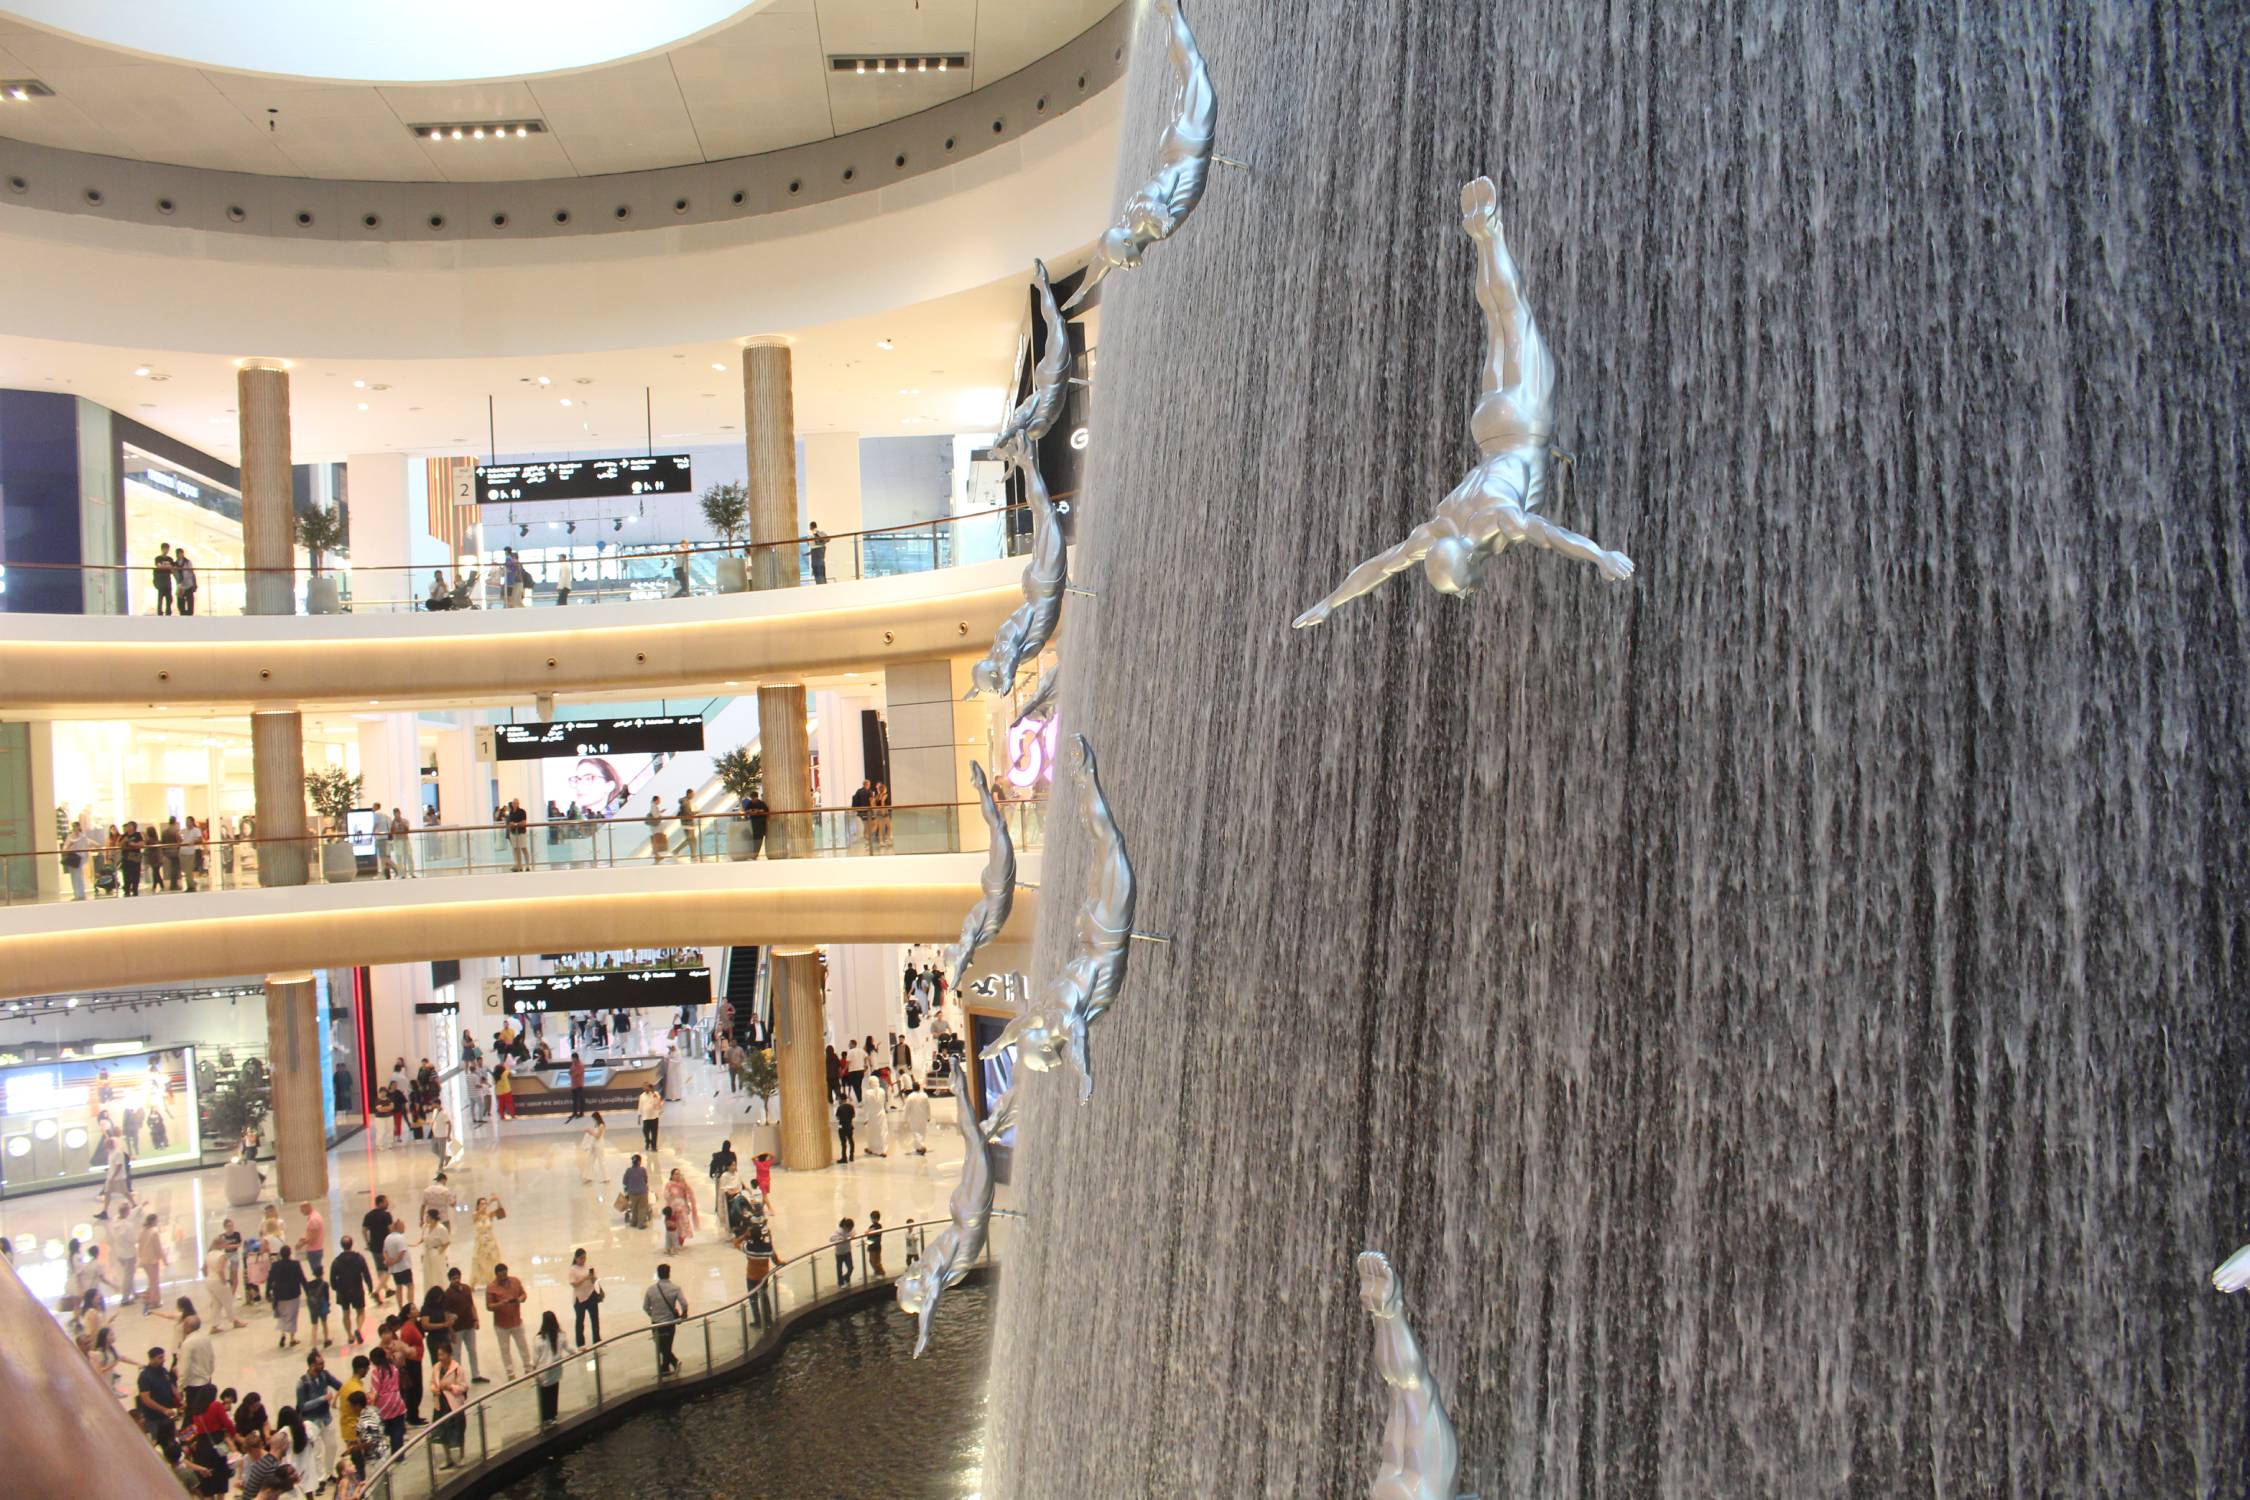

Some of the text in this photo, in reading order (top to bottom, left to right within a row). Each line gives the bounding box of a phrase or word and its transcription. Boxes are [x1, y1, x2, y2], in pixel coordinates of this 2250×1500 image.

[460, 483, 470, 497] 2
[481, 741, 488, 754] 1
[487, 994, 498, 1008] G
